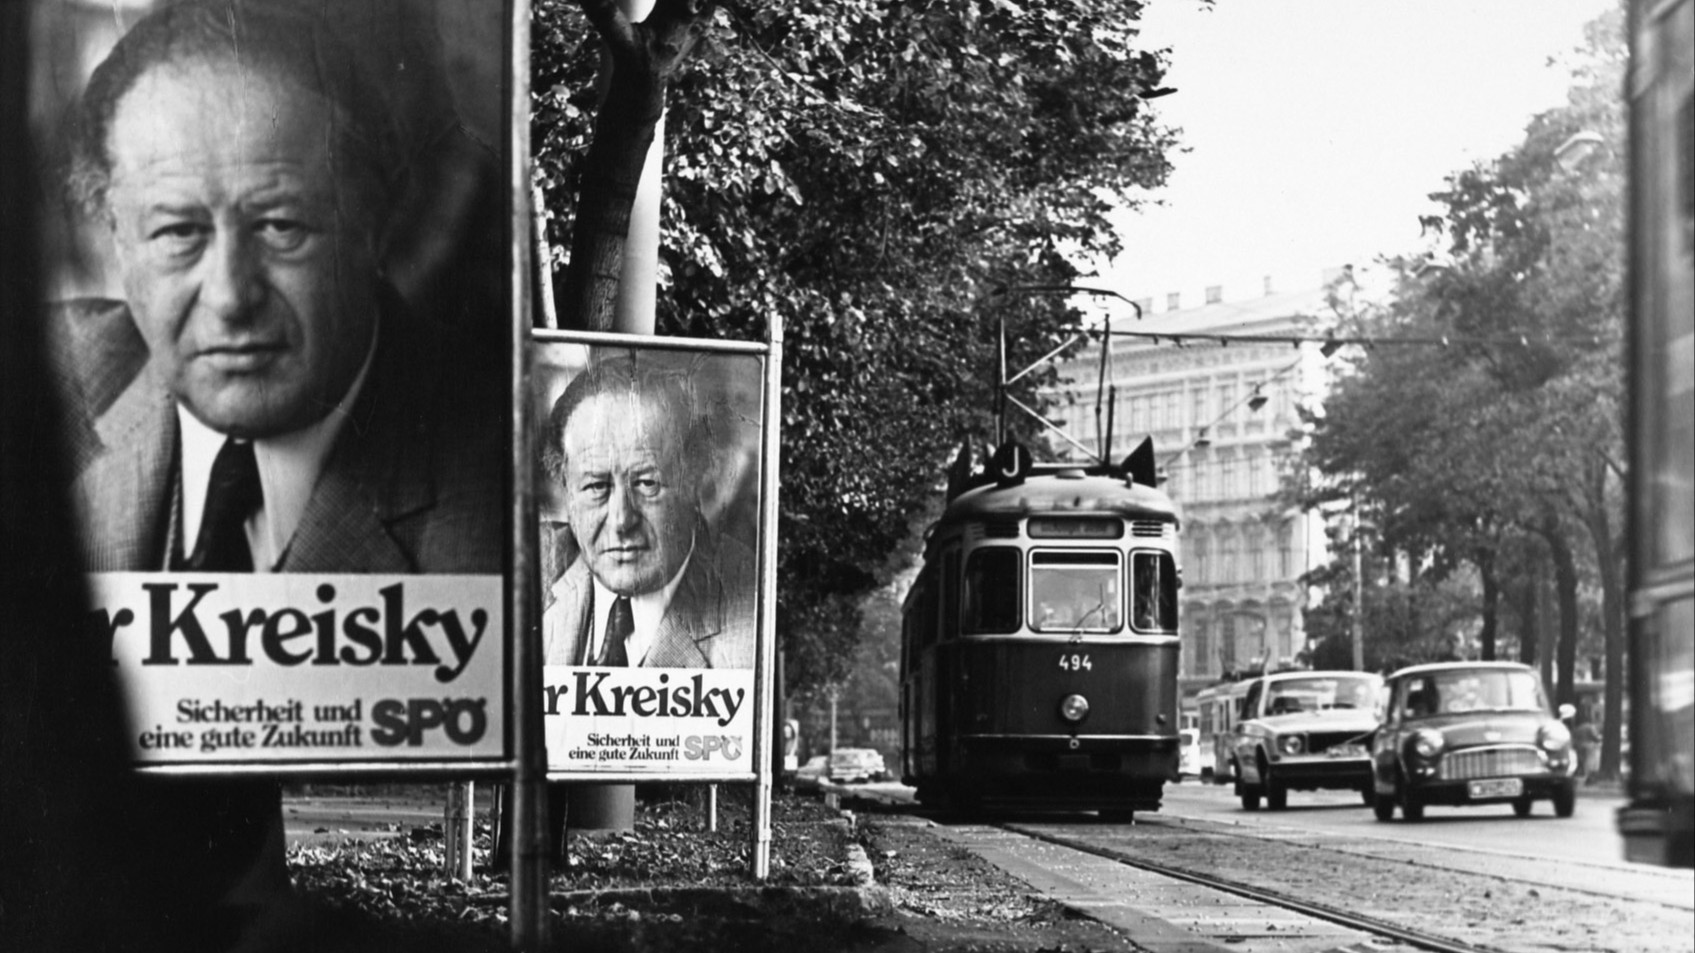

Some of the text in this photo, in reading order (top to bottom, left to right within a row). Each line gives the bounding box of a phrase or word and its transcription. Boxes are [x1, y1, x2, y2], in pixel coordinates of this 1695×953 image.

[1001, 446, 1019, 477] J
[141, 582, 489, 683] Kreisky
[1058, 655, 1092, 671] 494
[176, 698, 363, 724] Sicherheit und
[571, 671, 745, 727] Kreisky
[370, 697, 488, 748] SPÖ
[138, 723, 363, 753] eine gute Zukunft
[586, 733, 681, 747] Sicherheit und
[568, 747, 680, 762] eine gute Zukunft
